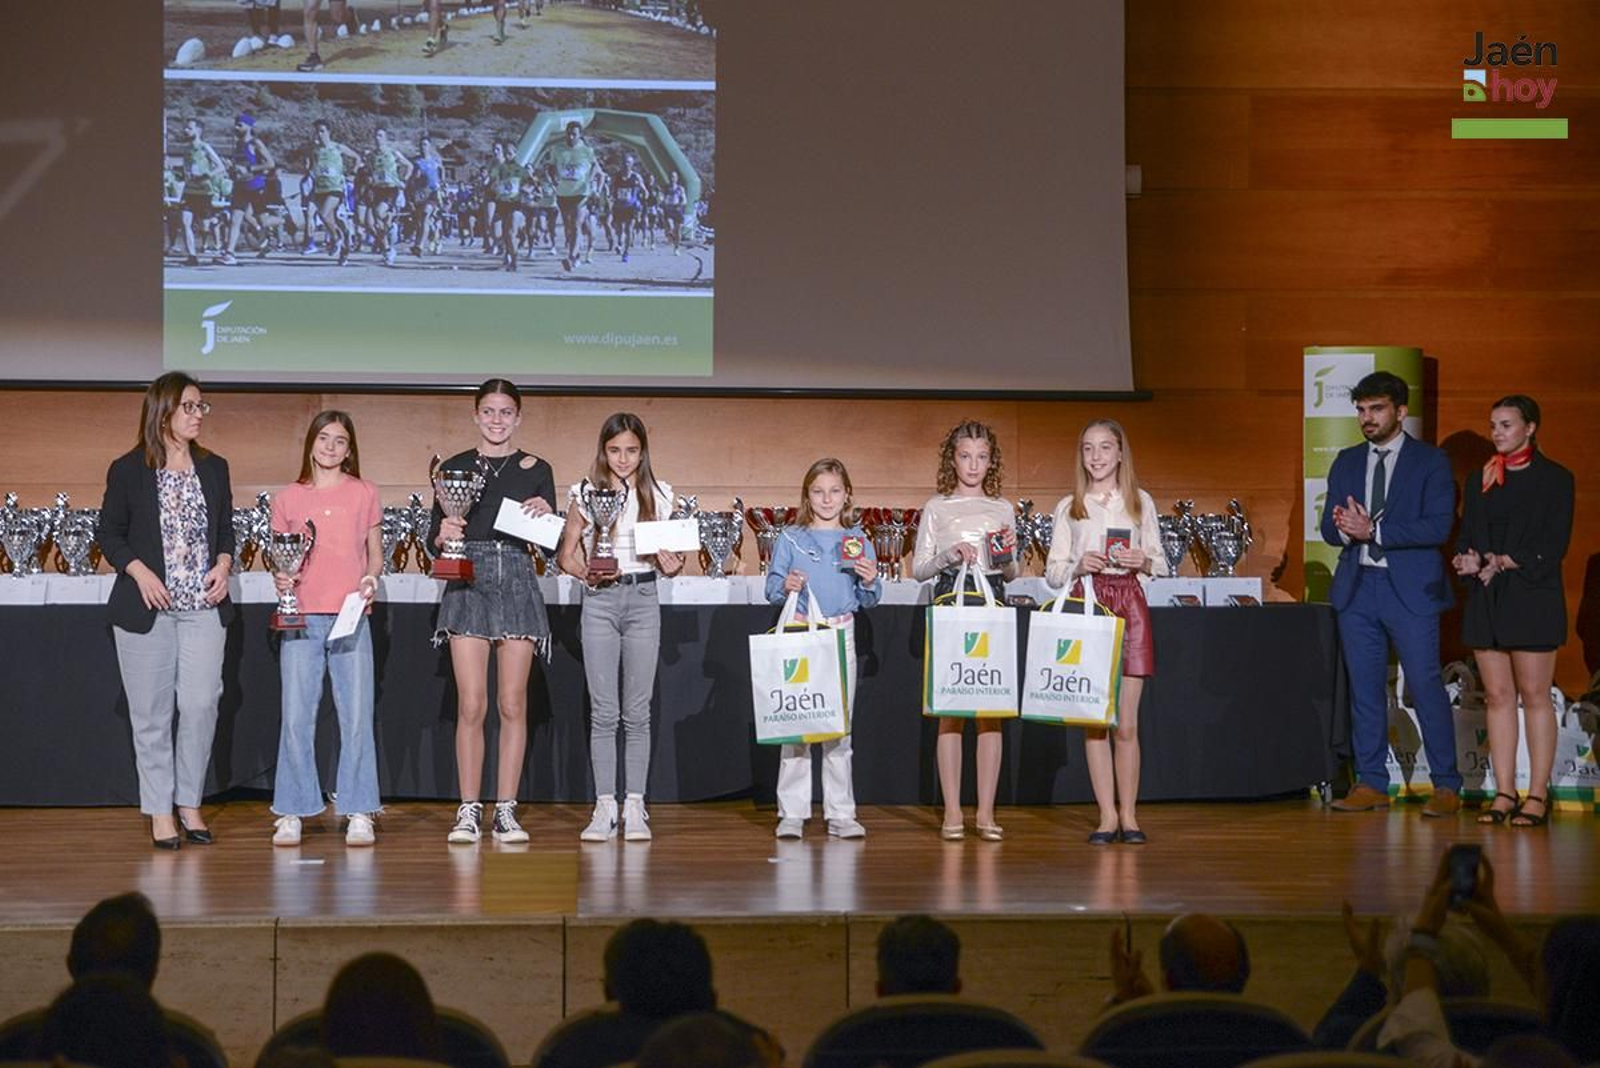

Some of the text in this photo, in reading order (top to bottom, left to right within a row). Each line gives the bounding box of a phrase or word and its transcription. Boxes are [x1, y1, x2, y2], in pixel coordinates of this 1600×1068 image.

[564, 332, 678, 347] www.dipujaen.es
[949, 663, 1002, 686] Jaén
[1040, 667, 1091, 694] Jaén
[770, 687, 825, 713] Jaén
[976, 687, 1011, 696] INTERIOR
